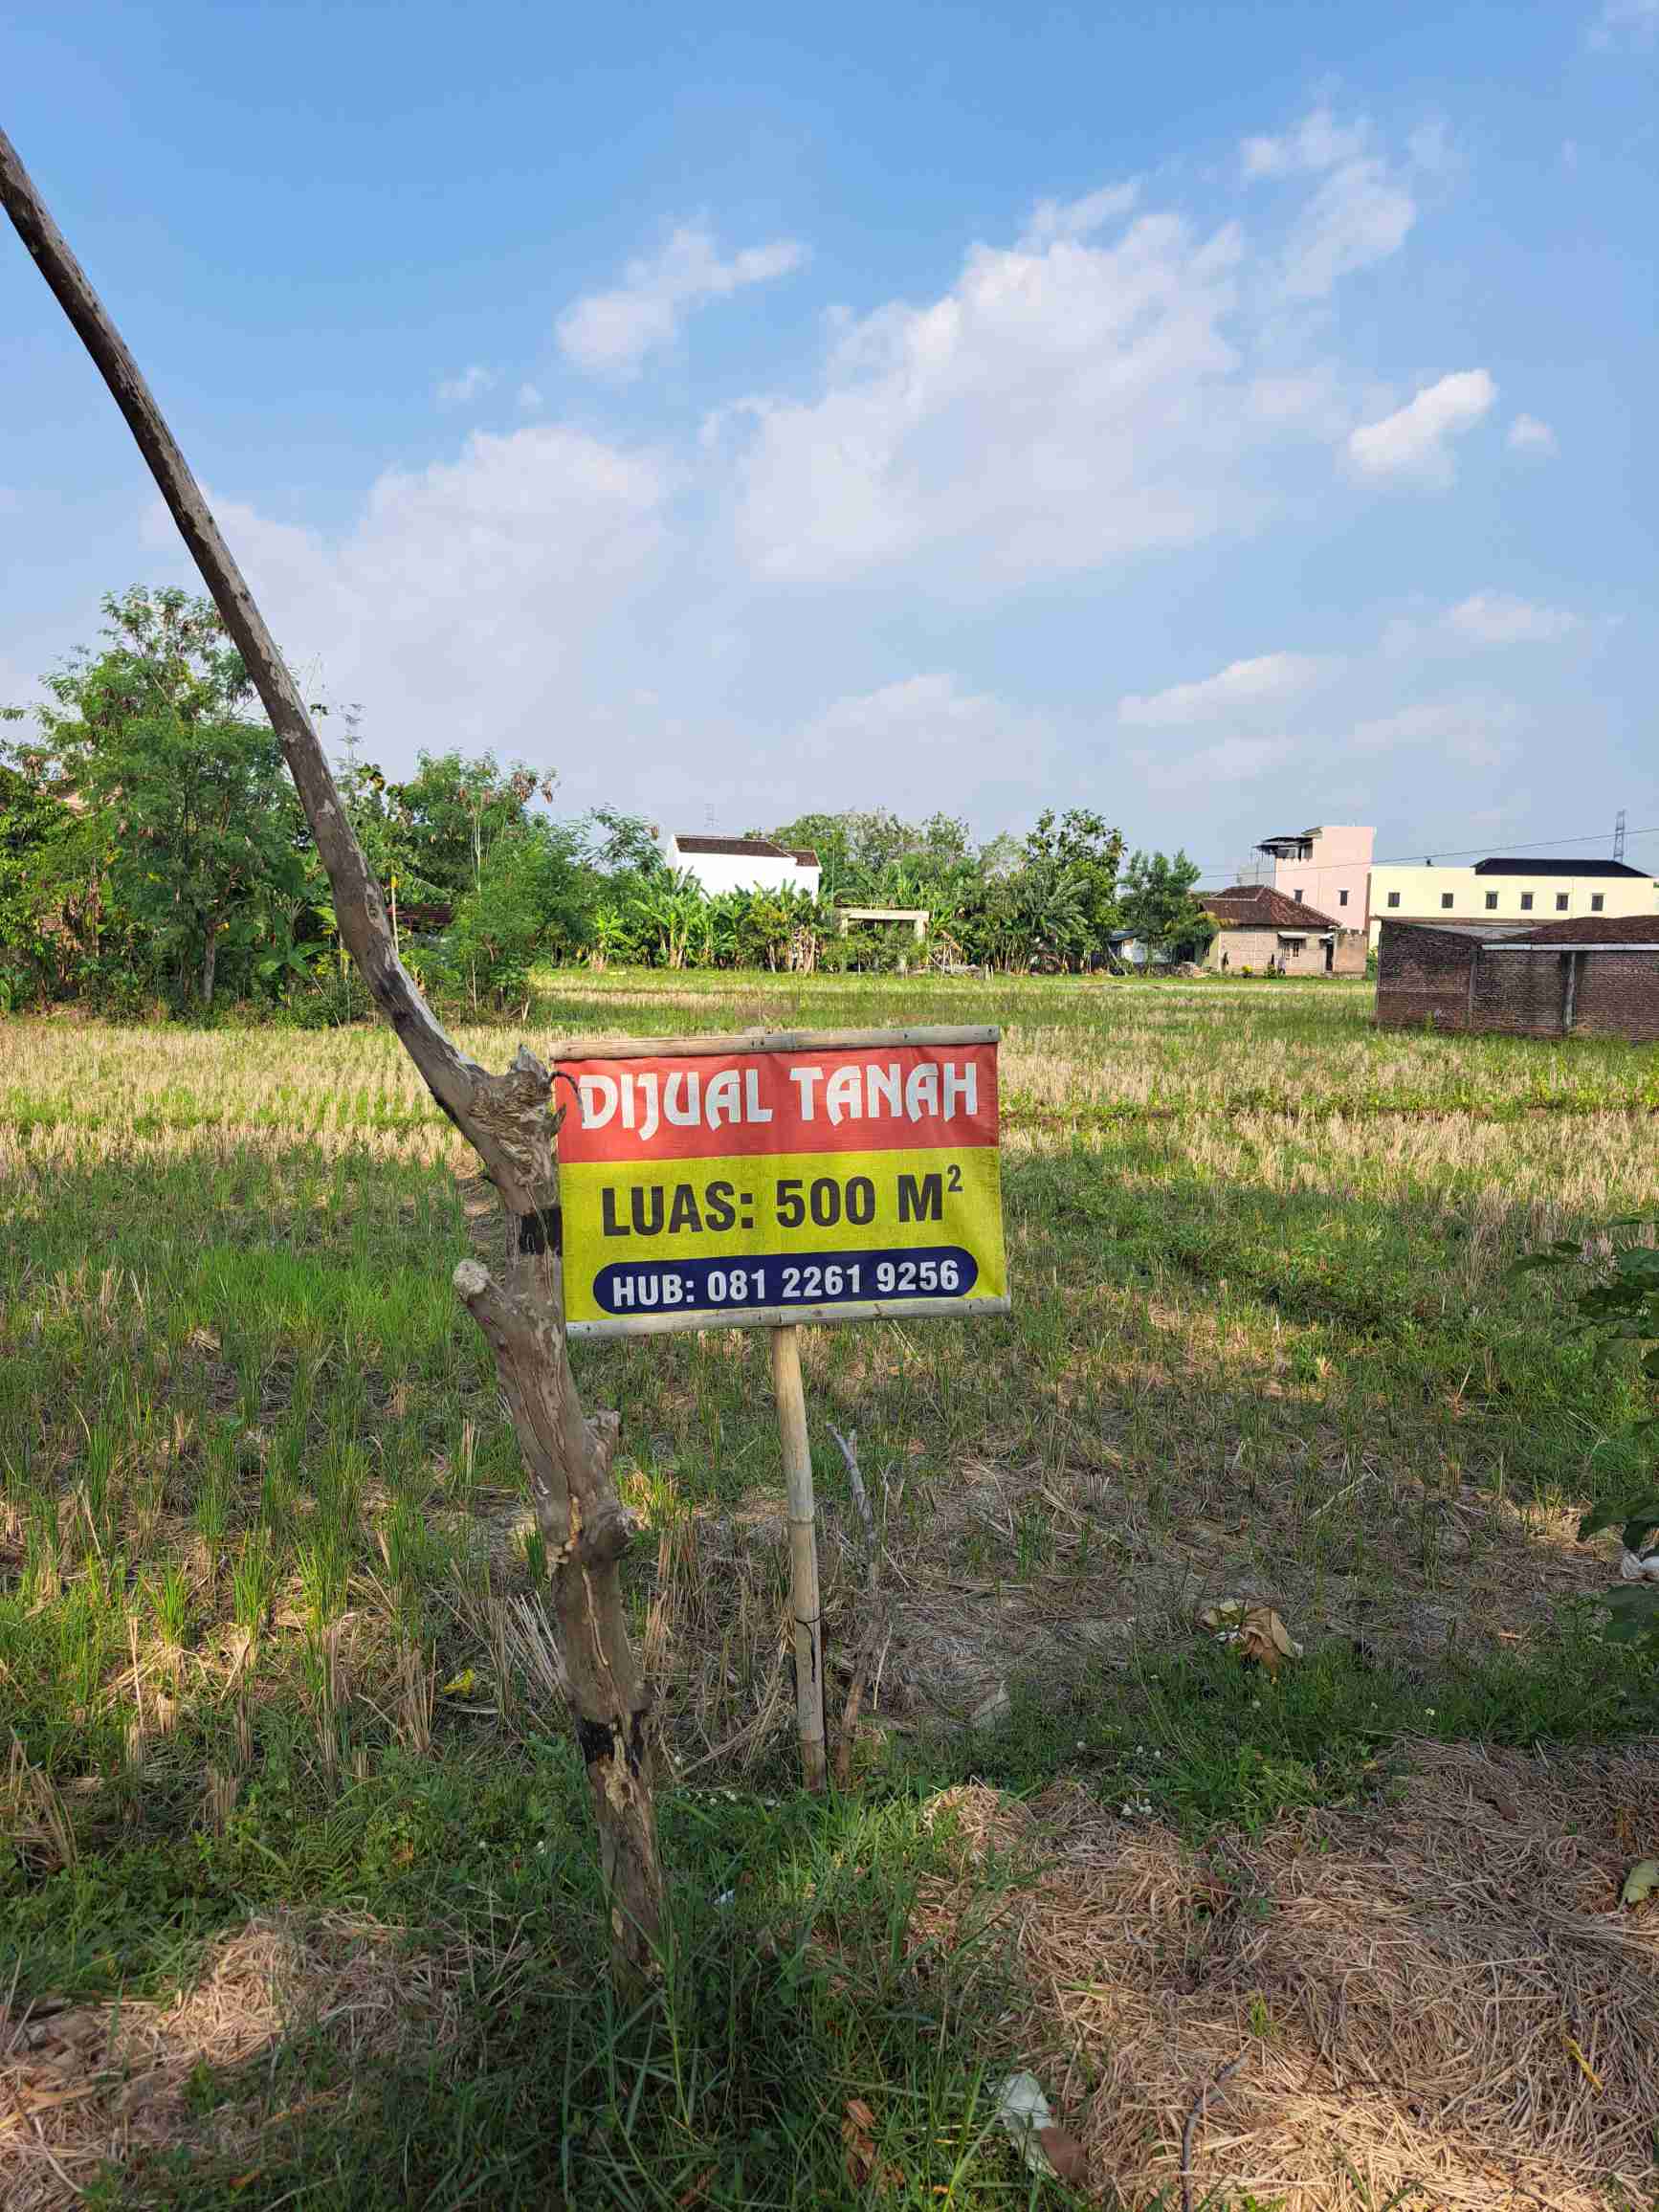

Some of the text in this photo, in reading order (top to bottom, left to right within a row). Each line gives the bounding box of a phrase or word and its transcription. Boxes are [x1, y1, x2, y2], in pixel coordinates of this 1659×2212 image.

[579, 1062, 978, 1140] DIJUAL TANAH
[601, 1181, 754, 1237] LUAS:
[776, 1177, 875, 1228] 500
[612, 1259, 960, 1307] HUB: 081 2261 9256
